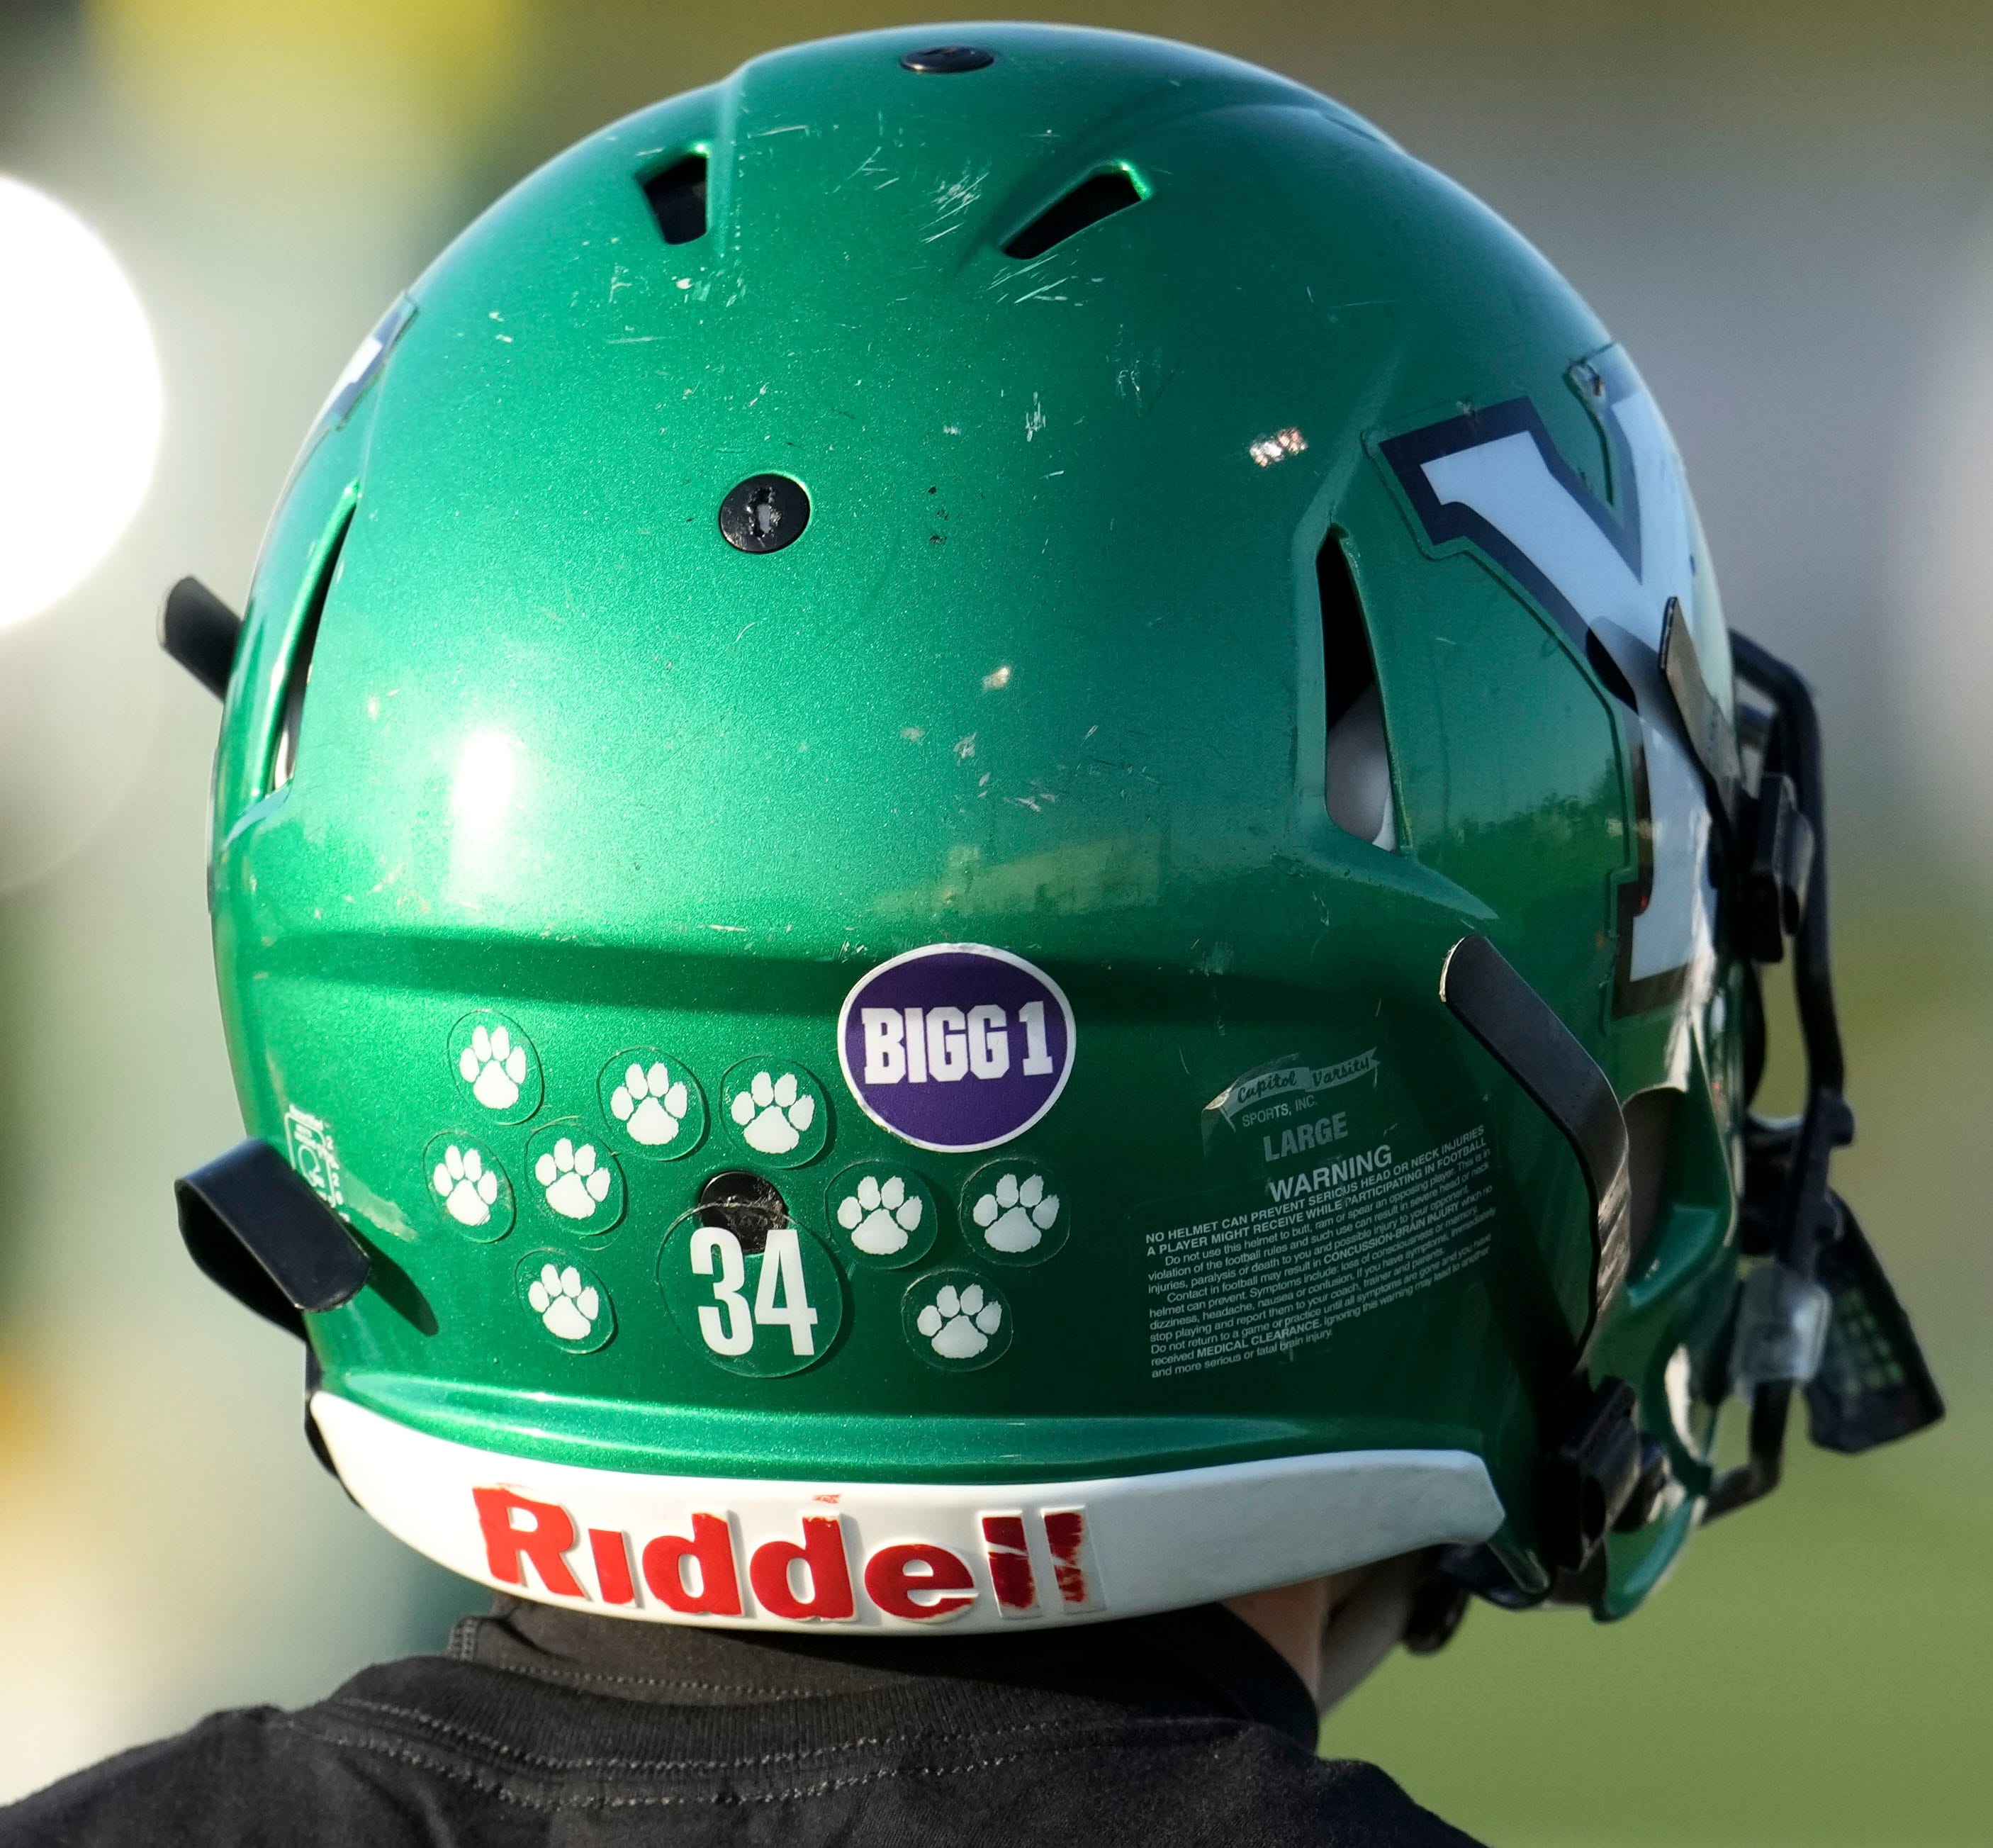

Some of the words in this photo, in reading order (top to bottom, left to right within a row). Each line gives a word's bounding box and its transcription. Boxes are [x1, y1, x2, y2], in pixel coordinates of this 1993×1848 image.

[860, 1004, 1010, 1085] BIGG
[1019, 1001, 1054, 1075] 1
[1237, 1074, 1297, 1103] Capitol
[1311, 1056, 1371, 1088] Varsity
[1242, 1104, 1292, 1128] SPORTS,
[1295, 1094, 1318, 1111] INC.
[1262, 1111, 1349, 1163] LARGE
[1146, 1232, 1164, 1243] NO
[1168, 1221, 1218, 1240] HELMET
[1222, 1214, 1247, 1228] CAN
[1251, 1199, 1305, 1222] PREVENT
[1308, 1182, 1357, 1206] SERIOUS
[1361, 1170, 1391, 1189] HEAD
[1393, 1162, 1408, 1175] OR
[1411, 1148, 1439, 1168] NECK
[1442, 1125, 1485, 1154] INJURIES
[1147, 1246, 1155, 1256] A
[1159, 1236, 1208, 1254] PLAYER
[1211, 1226, 1250, 1244] MIGHT
[1253, 1212, 1303, 1234] RECEIVE
[1306, 1199, 1342, 1219] WHILE
[1344, 1169, 1422, 1207] PARTICIPATING
[1425, 1163, 1435, 1175] IN
[1437, 1137, 1486, 1169] FOOTBALL
[1165, 1255, 1180, 1266] Do
[1183, 1251, 1200, 1262] not
[1202, 1248, 1221, 1258] use
[1224, 1243, 1241, 1254] this
[1244, 1232, 1277, 1249] helmet
[1280, 1231, 1290, 1240] to
[1292, 1223, 1313, 1236] butt,
[1315, 1217, 1333, 1229] ram
[1336, 1214, 1345, 1223] or
[1347, 1203, 1374, 1220] spear
[1376, 1198, 1387, 1209] an
[1389, 1180, 1428, 1204] opposing
[1457, 1158, 1473, 1171] This
[1269, 1144, 1393, 1202] WARNING
[1148, 1267, 1191, 1281] violation
[1194, 1262, 1203, 1273] of
[1206, 1260, 1223, 1270] the
[1225, 1249, 1261, 1266] football
[1264, 1244, 1288, 1257] rules
[1290, 1236, 1309, 1250] and
[1311, 1229, 1333, 1243] such
[1336, 1223, 1353, 1236] use
[1354, 1216, 1372, 1228] can
[1374, 1205, 1398, 1221] result
[1400, 1202, 1408, 1211] in
[1410, 1189, 1437, 1207] severe
[1439, 1176, 1460, 1193] head
[1461, 1171, 1469, 1182] or
[1472, 1163, 1488, 1175] neck
[1148, 1280, 1188, 1294] injuries,
[1191, 1269, 1236, 1289] paralysis
[1239, 1265, 1249, 1275] or
[1252, 1258, 1279, 1272] death
[1282, 1255, 1291, 1265] to
[1293, 1249, 1311, 1263] you
[1314, 1241, 1332, 1255] and
[1334, 1228, 1371, 1250] possible
[1374, 1219, 1397, 1233] injury
[1400, 1214, 1408, 1223] to
[1410, 1205, 1428, 1221] your
[1167, 1287, 1208, 1303] Contact
[1211, 1284, 1219, 1294] in
[1223, 1275, 1258, 1292] football
[1261, 1270, 1281, 1283] may
[1284, 1261, 1310, 1277] result
[1313, 1258, 1321, 1267] in
[1427, 1201, 1459, 1224] INJURY
[1461, 1191, 1481, 1206] which
[690, 1226, 818, 1357] 34
[1150, 1304, 1184, 1318] helmet
[1187, 1301, 1206, 1311] can
[1208, 1291, 1247, 1309] prevent.
[1250, 1277, 1302, 1299] Symptoms
[1341, 1258, 1359, 1271] loss
[1362, 1253, 1370, 1264] of
[1372, 1228, 1434, 1260] consciousness
[1435, 1223, 1444, 1233] or
[1150, 1315, 1200, 1330] dizziness,
[1203, 1303, 1254, 1321] headache,
[1257, 1292, 1293, 1308] nausea
[1296, 1288, 1306, 1298] or
[1357, 1267, 1362, 1278] If
[1364, 1263, 1381, 1278] you
[1383, 1253, 1403, 1268] have
[1150, 1332, 1172, 1342] stop
[1175, 1324, 1212, 1340] playing
[1215, 1318, 1234, 1331] and
[1237, 1311, 1267, 1326] report
[1269, 1304, 1294, 1317] them
[1308, 1293, 1329, 1311] your
[1364, 1270, 1391, 1287] trainer
[1393, 1262, 1410, 1276] and
[1151, 1344, 1167, 1355] Do
[1169, 1340, 1186, 1351] not
[1188, 1334, 1218, 1348] return
[1220, 1332, 1230, 1341] to
[1233, 1330, 1239, 1338] a
[1242, 1323, 1269, 1339] game
[1272, 1319, 1283, 1328] or
[1284, 1308, 1321, 1328] practice
[1324, 1298, 1342, 1314] until
[1344, 1295, 1355, 1307] all
[1357, 1278, 1403, 1304] symptoms
[1404, 1272, 1417, 1284] are
[1419, 1261, 1440, 1279] gone
[1442, 1251, 1457, 1266] and
[1459, 1244, 1472, 1260] you
[1151, 1349, 1194, 1367] received
[1197, 1339, 1249, 1358] MEDICAL
[1251, 1318, 1322, 1345] CLEARANCE.
[1324, 1306, 1361, 1326] Ignoring
[1362, 1300, 1378, 1311] this
[1379, 1285, 1413, 1305] warning
[1415, 1277, 1432, 1290] may
[1434, 1265, 1451, 1282] lead
[1452, 1263, 1460, 1272] to
[1152, 1365, 1172, 1378] and
[1174, 1362, 1201, 1374] more
[1204, 1354, 1241, 1369] serious
[1244, 1350, 1254, 1360] or
[1257, 1342, 1277, 1356] fatal
[1280, 1337, 1303, 1352] brain
[471, 1484, 1100, 1622] Riddell
